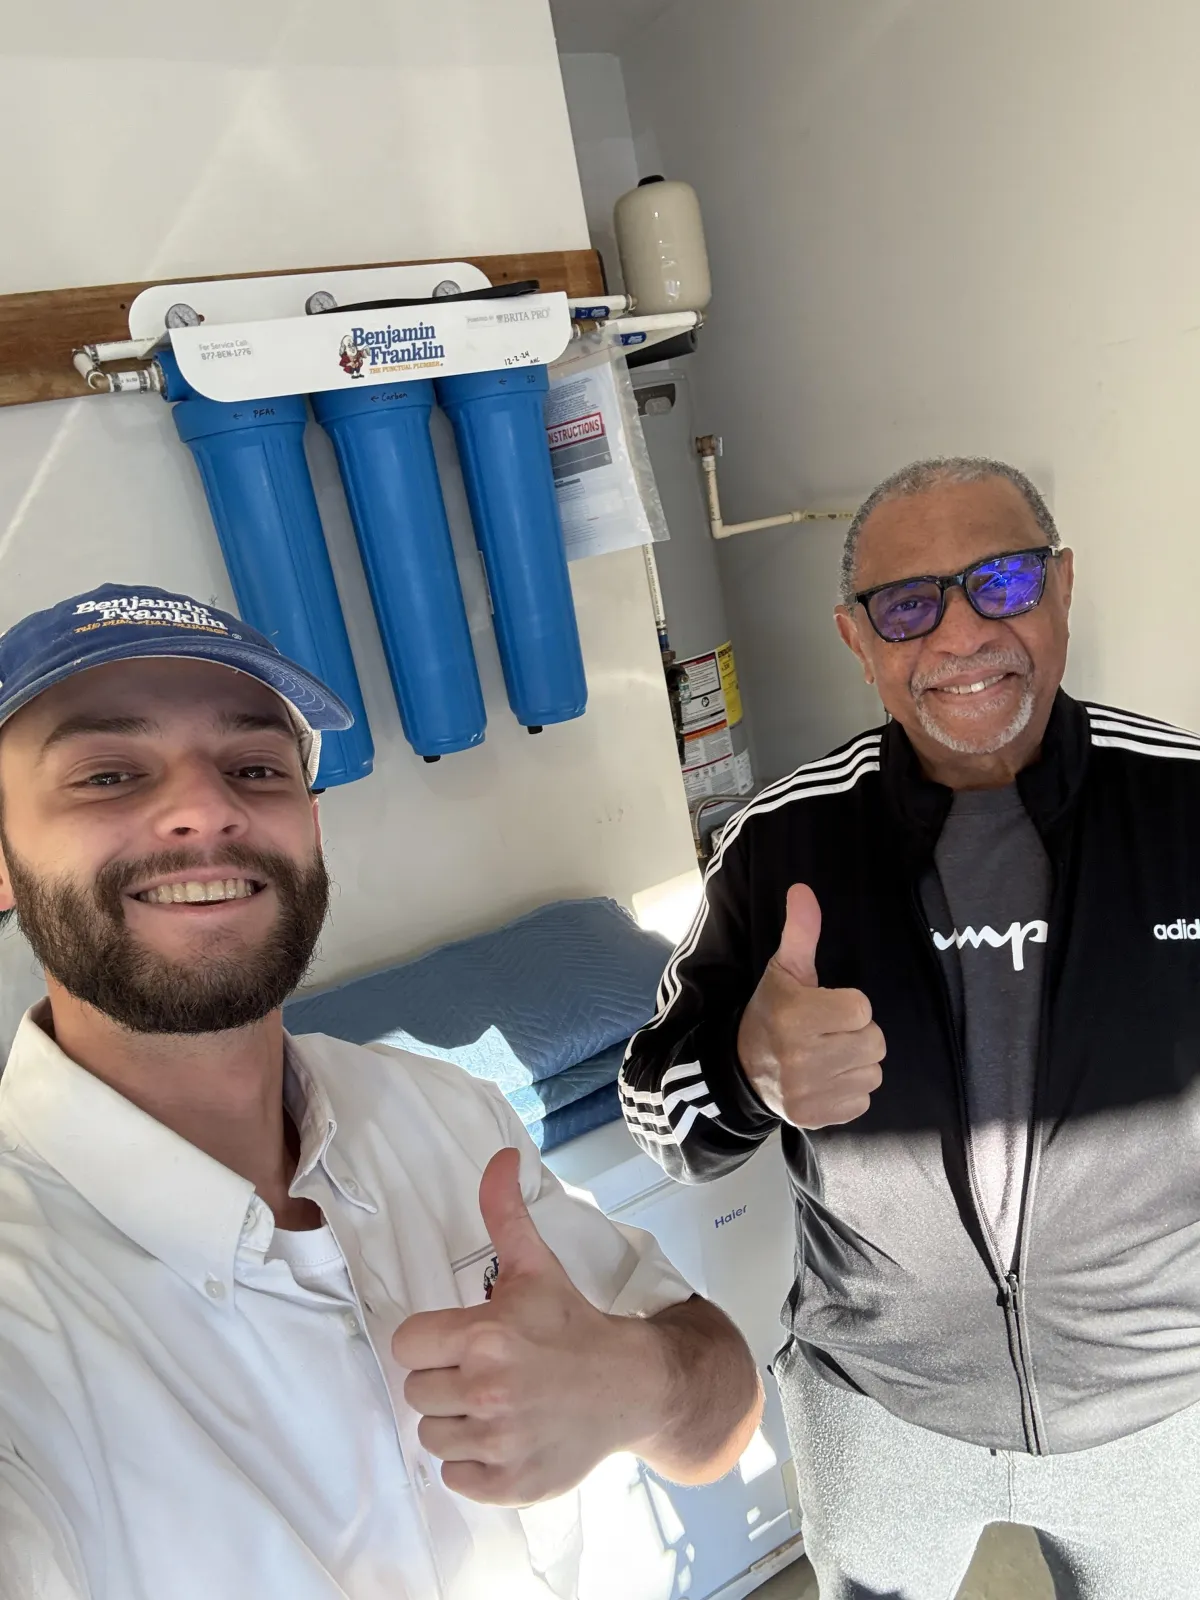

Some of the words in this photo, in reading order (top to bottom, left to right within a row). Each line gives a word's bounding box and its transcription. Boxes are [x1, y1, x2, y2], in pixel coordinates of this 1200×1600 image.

[503, 311, 530, 323] BRITA
[351, 321, 436, 349] Benjamin
[210, 341, 234, 350] Service
[369, 341, 445, 366] Franklin
[382, 363, 412, 372] PUNCTUAL
[413, 360, 440, 369] PLUMBER
[381, 392, 408, 401] Carbon
[253, 408, 275, 419] PFAS
[72, 596, 212, 616] Benjamin
[97, 608, 229, 630] Franklin
[714, 1204, 747, 1229] Haier
